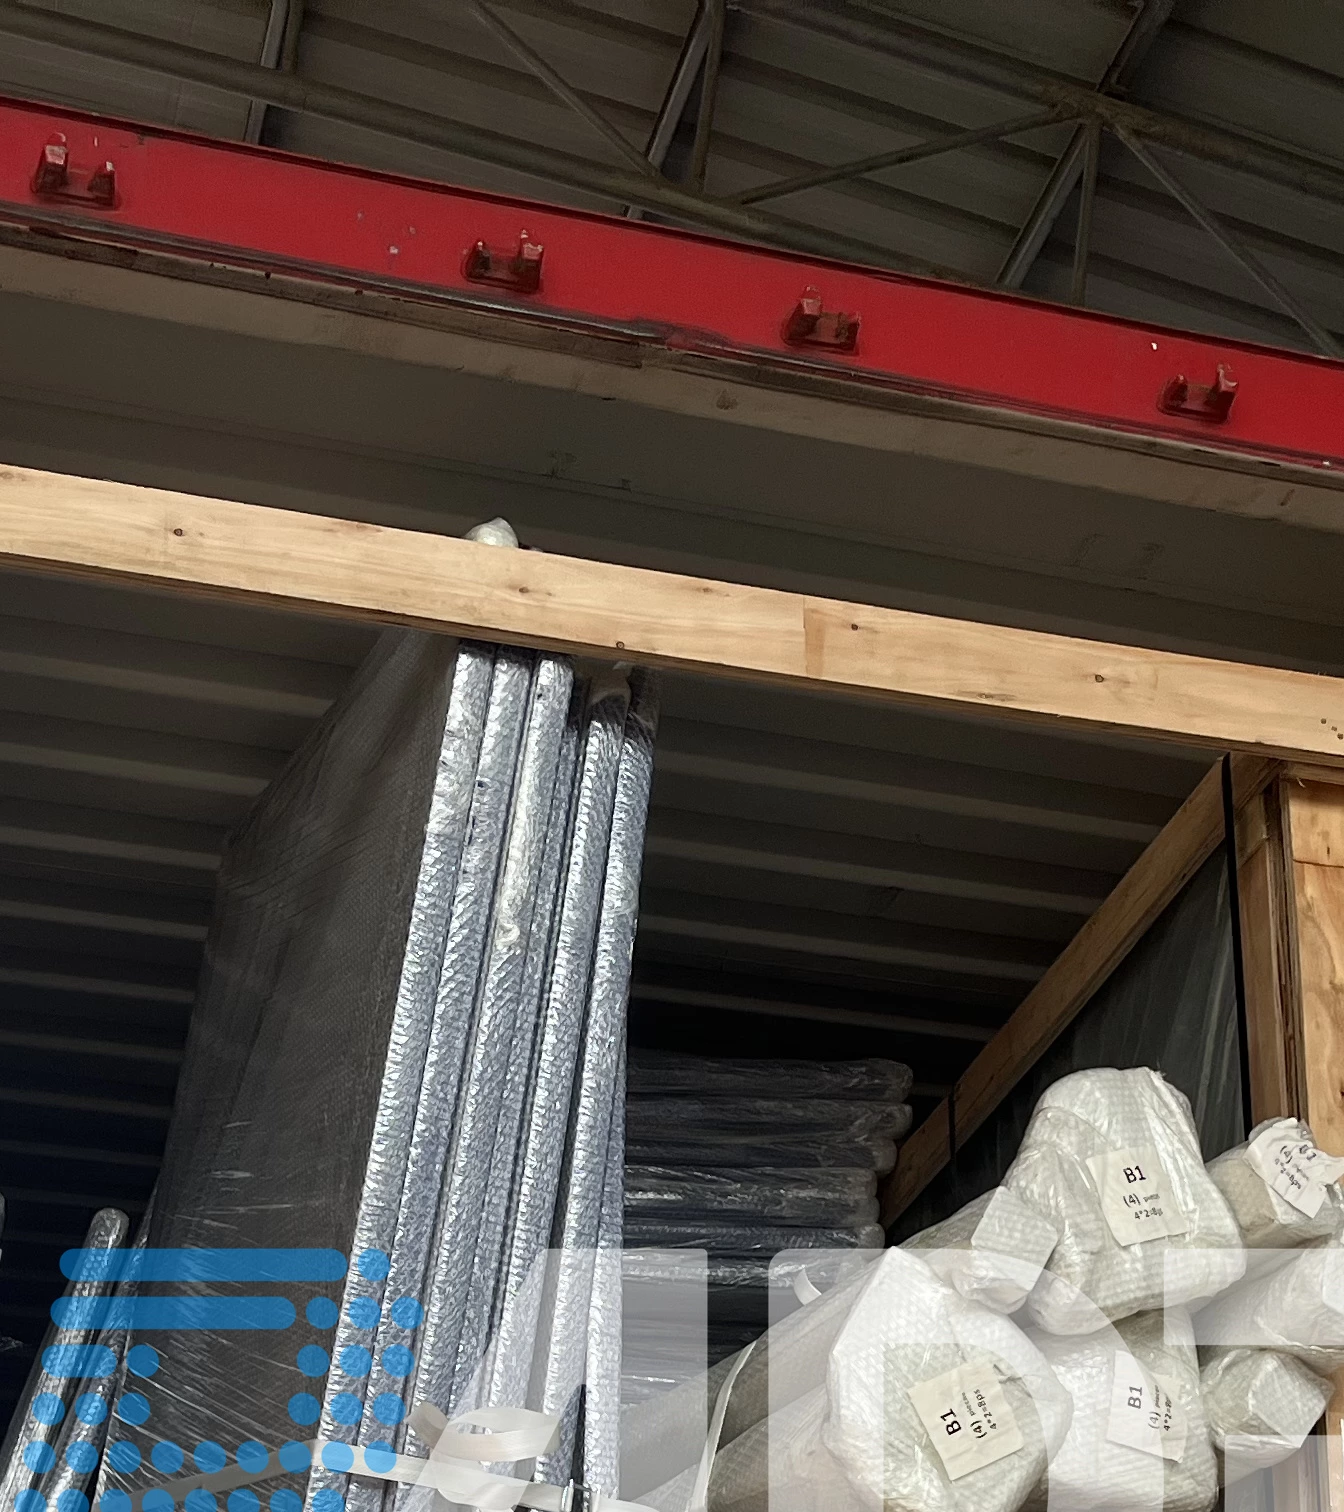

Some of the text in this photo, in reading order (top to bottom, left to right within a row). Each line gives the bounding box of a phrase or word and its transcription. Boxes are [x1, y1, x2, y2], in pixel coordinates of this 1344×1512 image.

[1122, 1165, 1146, 1184] B1
[1122, 1193, 1141, 1208] (4)
[1127, 1386, 1143, 1410] B1
[940, 1408, 962, 1436] B1
[970, 1420, 988, 1439] (4)
[1148, 1411, 1161, 1430] (4)
